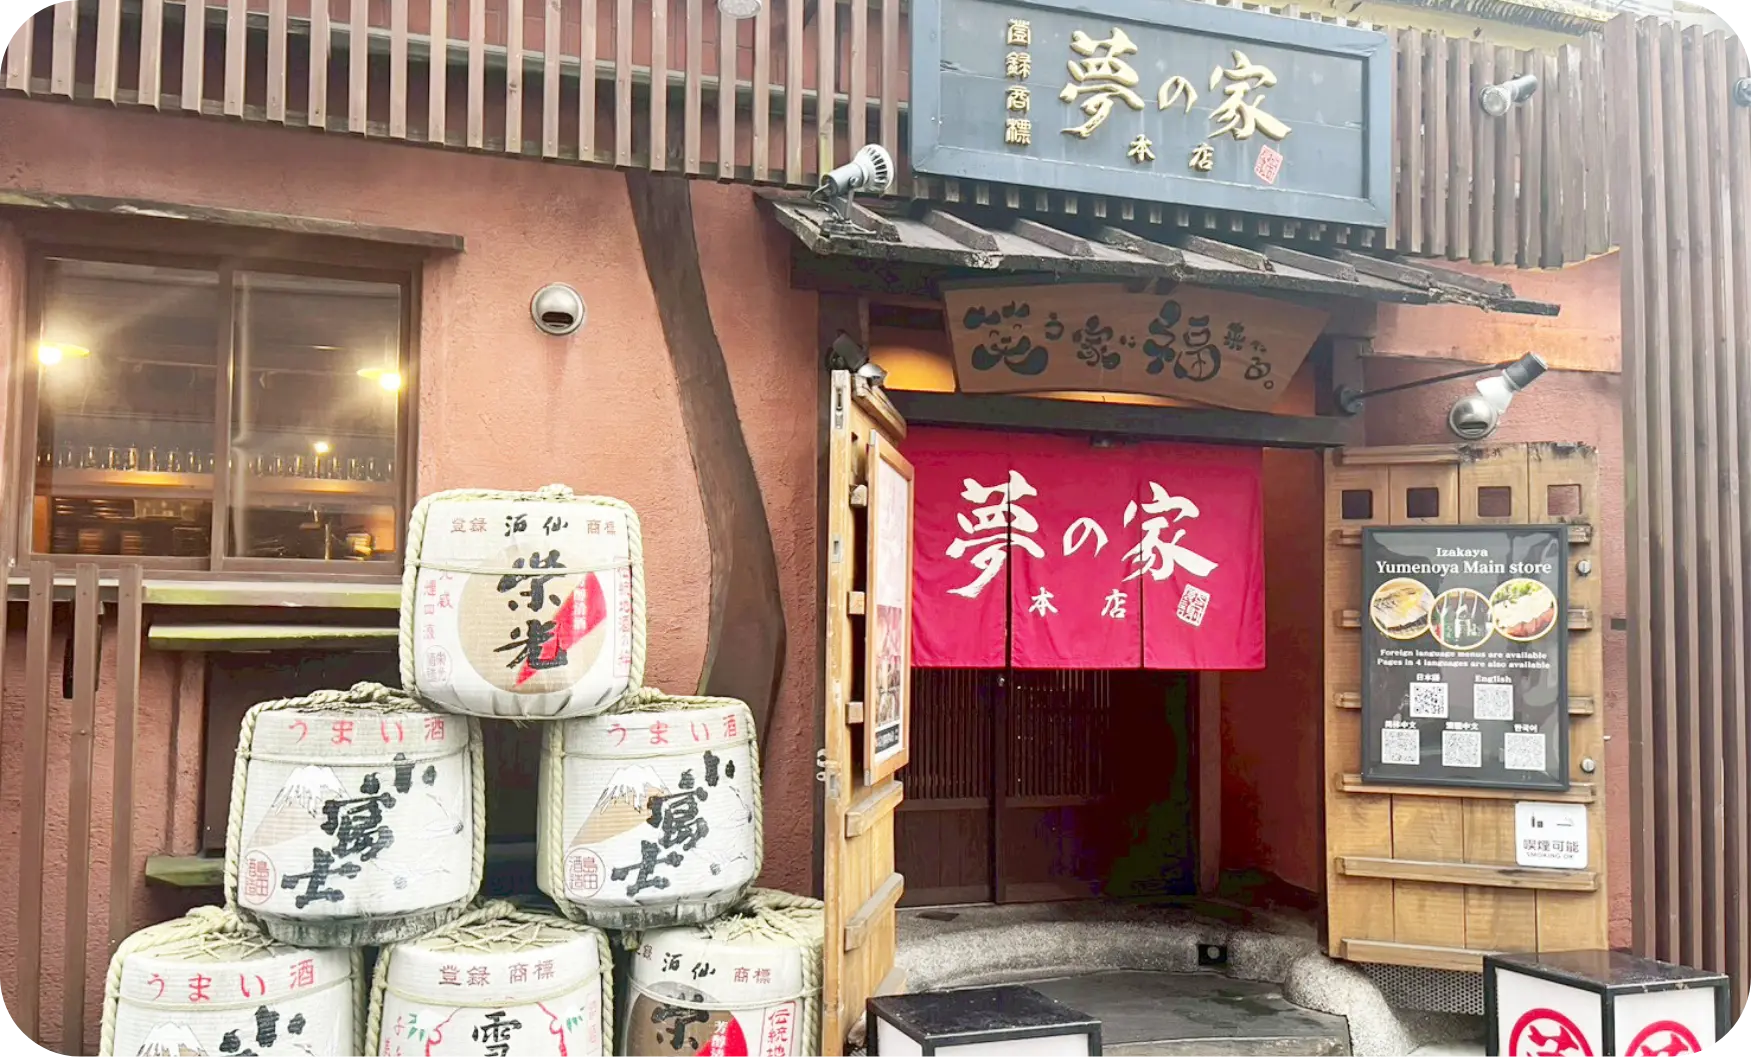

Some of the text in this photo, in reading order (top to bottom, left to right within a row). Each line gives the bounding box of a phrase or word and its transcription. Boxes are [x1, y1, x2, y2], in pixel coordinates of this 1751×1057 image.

[1059, 27, 1292, 141] 夢の家
[1127, 133, 1215, 173] 本店
[450, 517, 488, 533] 登録
[504, 513, 568, 537] 酒仙
[586, 518, 617, 536] 商標
[946, 470, 1219, 599] 夢の家
[1436, 547, 1488, 558] Izakaya
[1376, 560, 1552, 576] Yumenoya Main store
[1029, 586, 1128, 620] 本店
[1377, 658, 1402, 667] Pages
[1423, 659, 1468, 669] languages
[1487, 660, 1506, 669] also
[1508, 660, 1551, 669] available
[1380, 649, 1413, 658] Foreign
[1415, 650, 1456, 659] language
[1457, 651, 1486, 659] menus
[1505, 651, 1547, 660] available
[1474, 674, 1512, 684] English
[289, 717, 445, 744] うまい酒
[608, 714, 737, 746] うまい酒
[1523, 839, 1580, 853] 喫煙可能
[437, 959, 557, 988] 登録商標
[663, 952, 716, 980] 酒仙
[733, 966, 771, 984] 商標
[147, 958, 314, 1001] うまい酒
